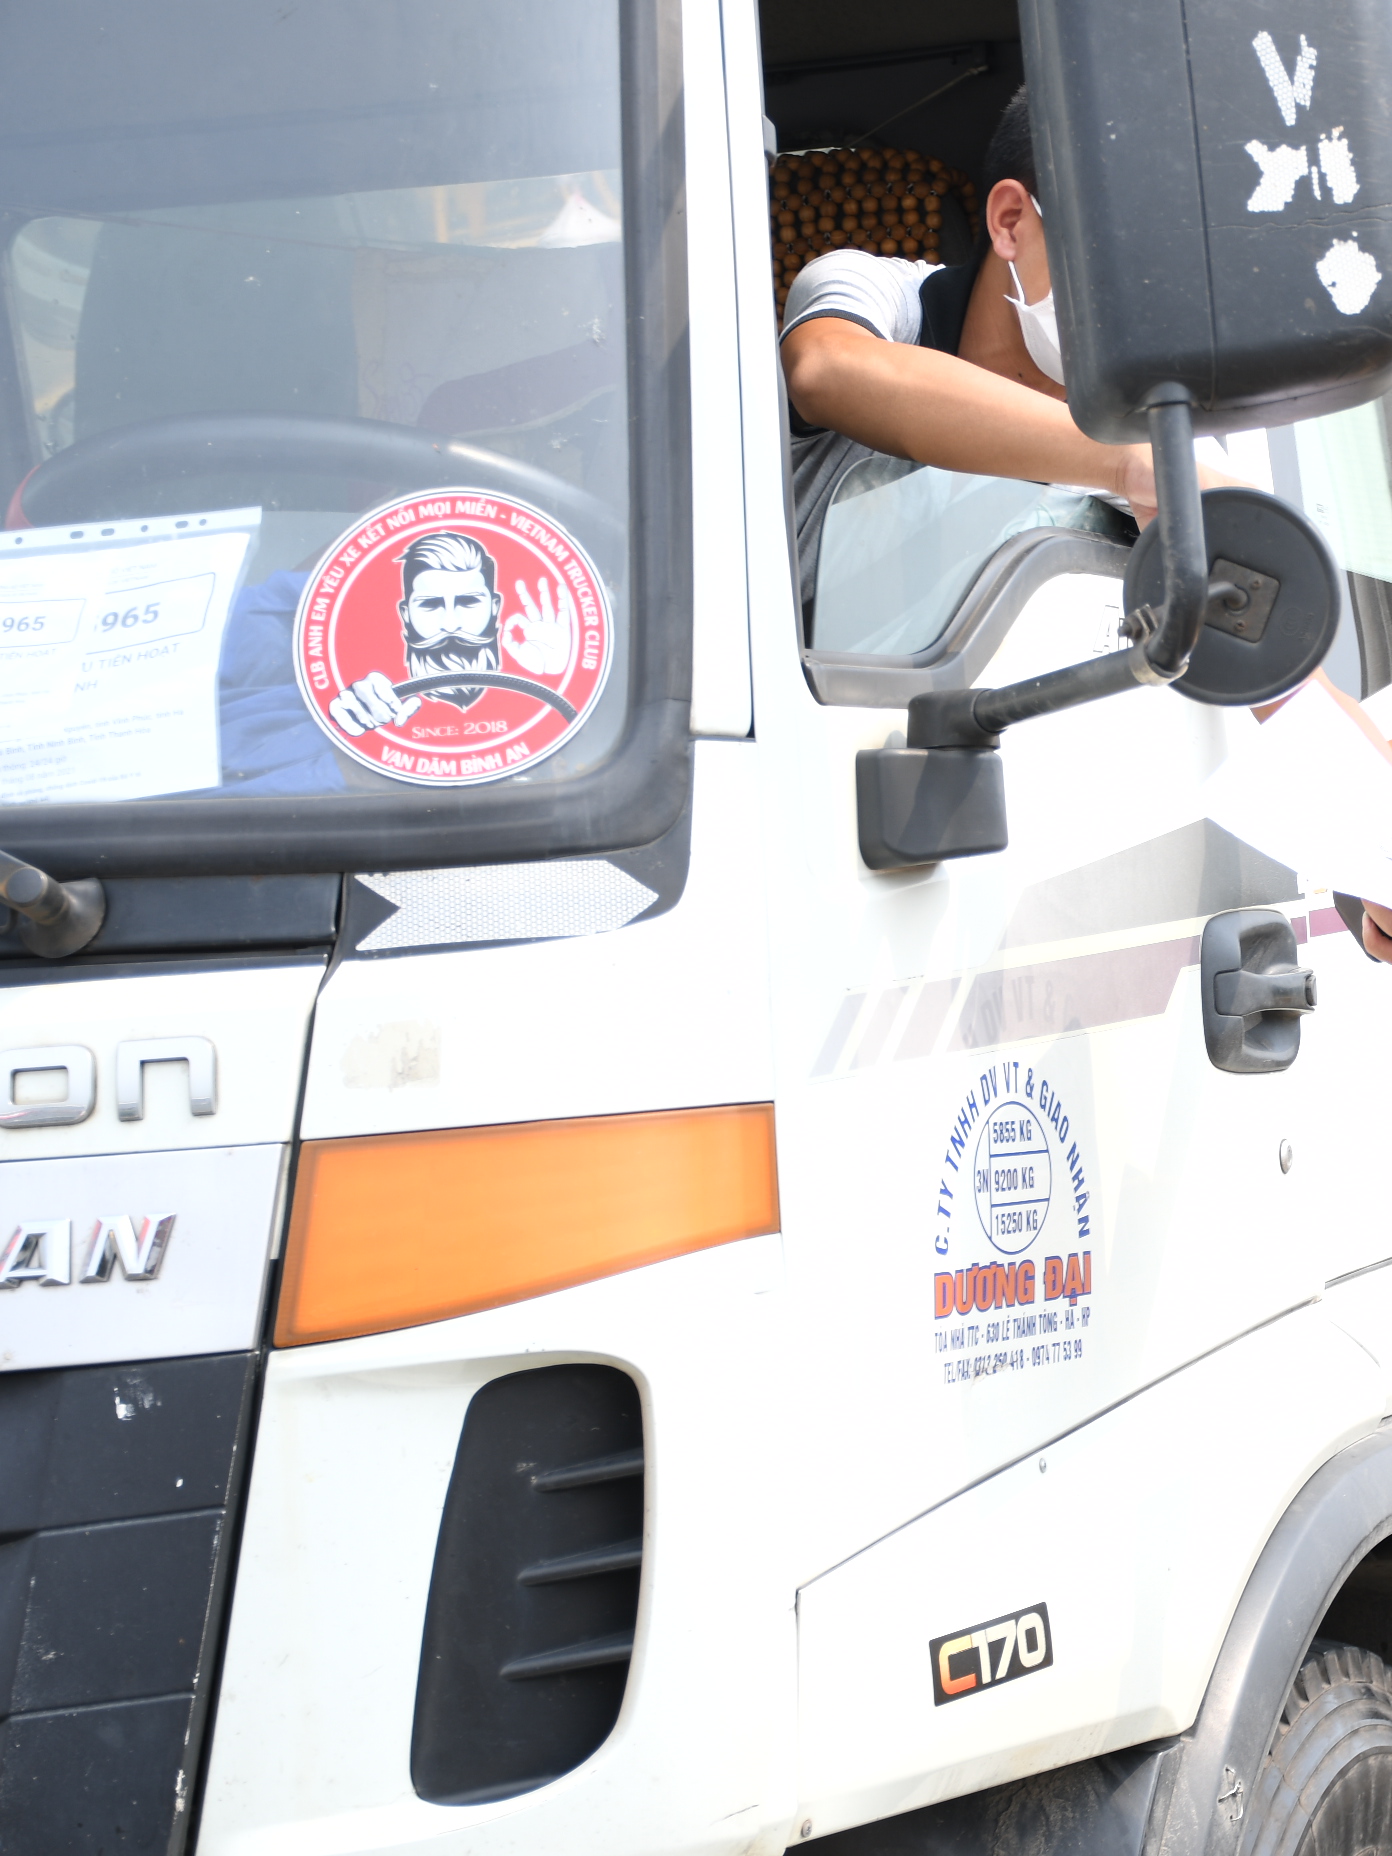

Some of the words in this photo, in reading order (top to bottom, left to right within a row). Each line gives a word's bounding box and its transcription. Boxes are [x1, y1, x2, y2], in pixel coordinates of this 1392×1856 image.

[418, 501, 451, 518] MỌI
[344, 544, 363, 567] XE
[319, 565, 345, 593] YÊU
[563, 558, 599, 628] TRUCKER
[101, 602, 161, 633] 965
[310, 597, 331, 621] EM
[2, 615, 46, 636] 965
[308, 625, 324, 657] ANH
[581, 629, 600, 671] CLUB
[309, 661, 330, 690] CLB
[463, 720, 508, 735] 2018
[380, 745, 415, 769] VẠN
[460, 752, 503, 775] BÌNH
[505, 741, 531, 764] AN
[945, 1090, 979, 1172] TNHH
[980, 1066, 998, 1106] DV
[1003, 1062, 1019, 1093] VT
[1025, 1068, 1034, 1099] &
[1040, 1080, 1069, 1143] GIAO
[1019, 1119, 1032, 1142] KG
[994, 1168, 1018, 1192] 9200
[1022, 1166, 1034, 1189] KG
[995, 1212, 1022, 1236] 15250
[1026, 1209, 1038, 1232] KG
[934, 1259, 1035, 1320] DƯƠNG
[1043, 1251, 1091, 1307] ĐẠI
[967, 1325, 979, 1347] TTC
[1052, 1343, 1061, 1363] 77
[1063, 1340, 1072, 1361] 53
[1074, 1339, 1083, 1359] 99
